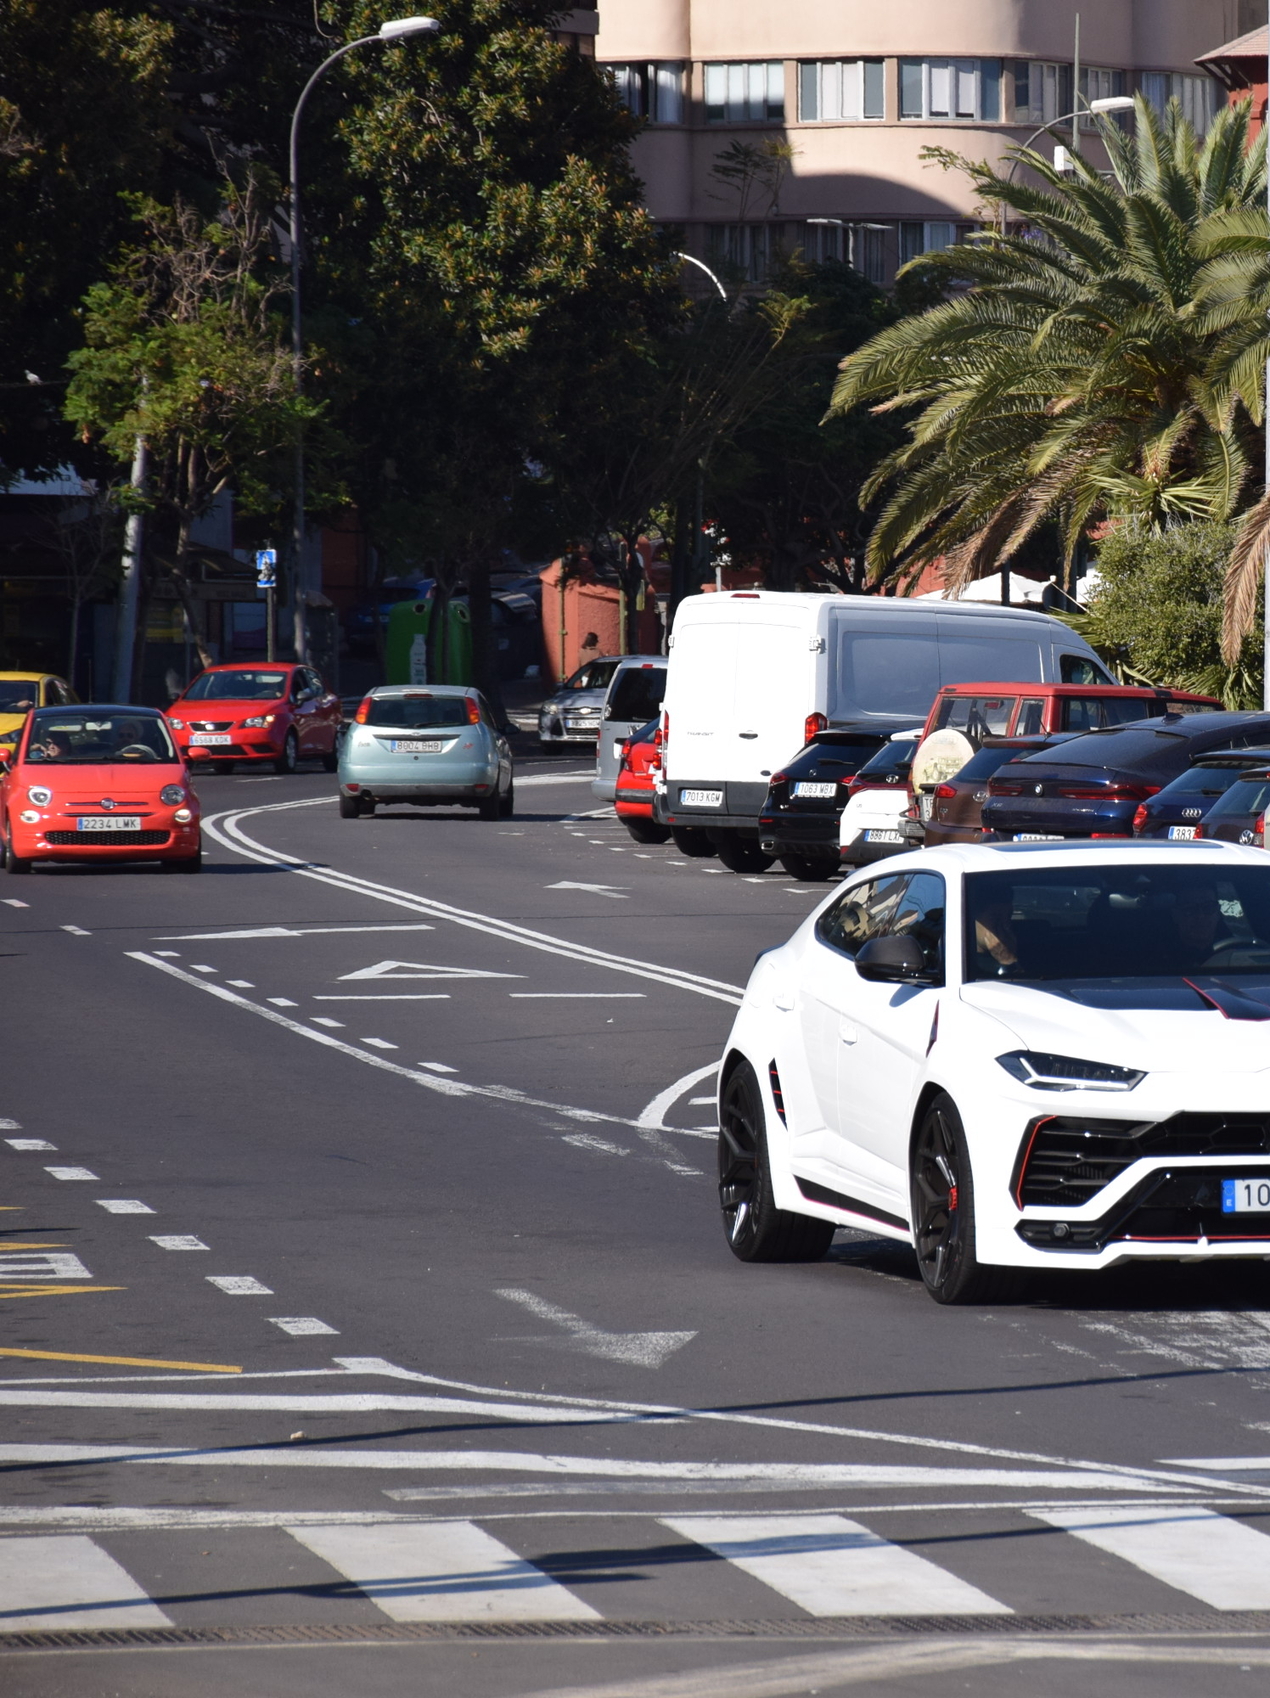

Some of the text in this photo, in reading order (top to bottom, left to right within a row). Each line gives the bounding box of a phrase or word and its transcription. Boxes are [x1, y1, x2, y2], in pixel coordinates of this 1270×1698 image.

[800, 783, 819, 794] 1063
[686, 791, 705, 802] 7013
[84, 818, 137, 830] 2234 LMK
